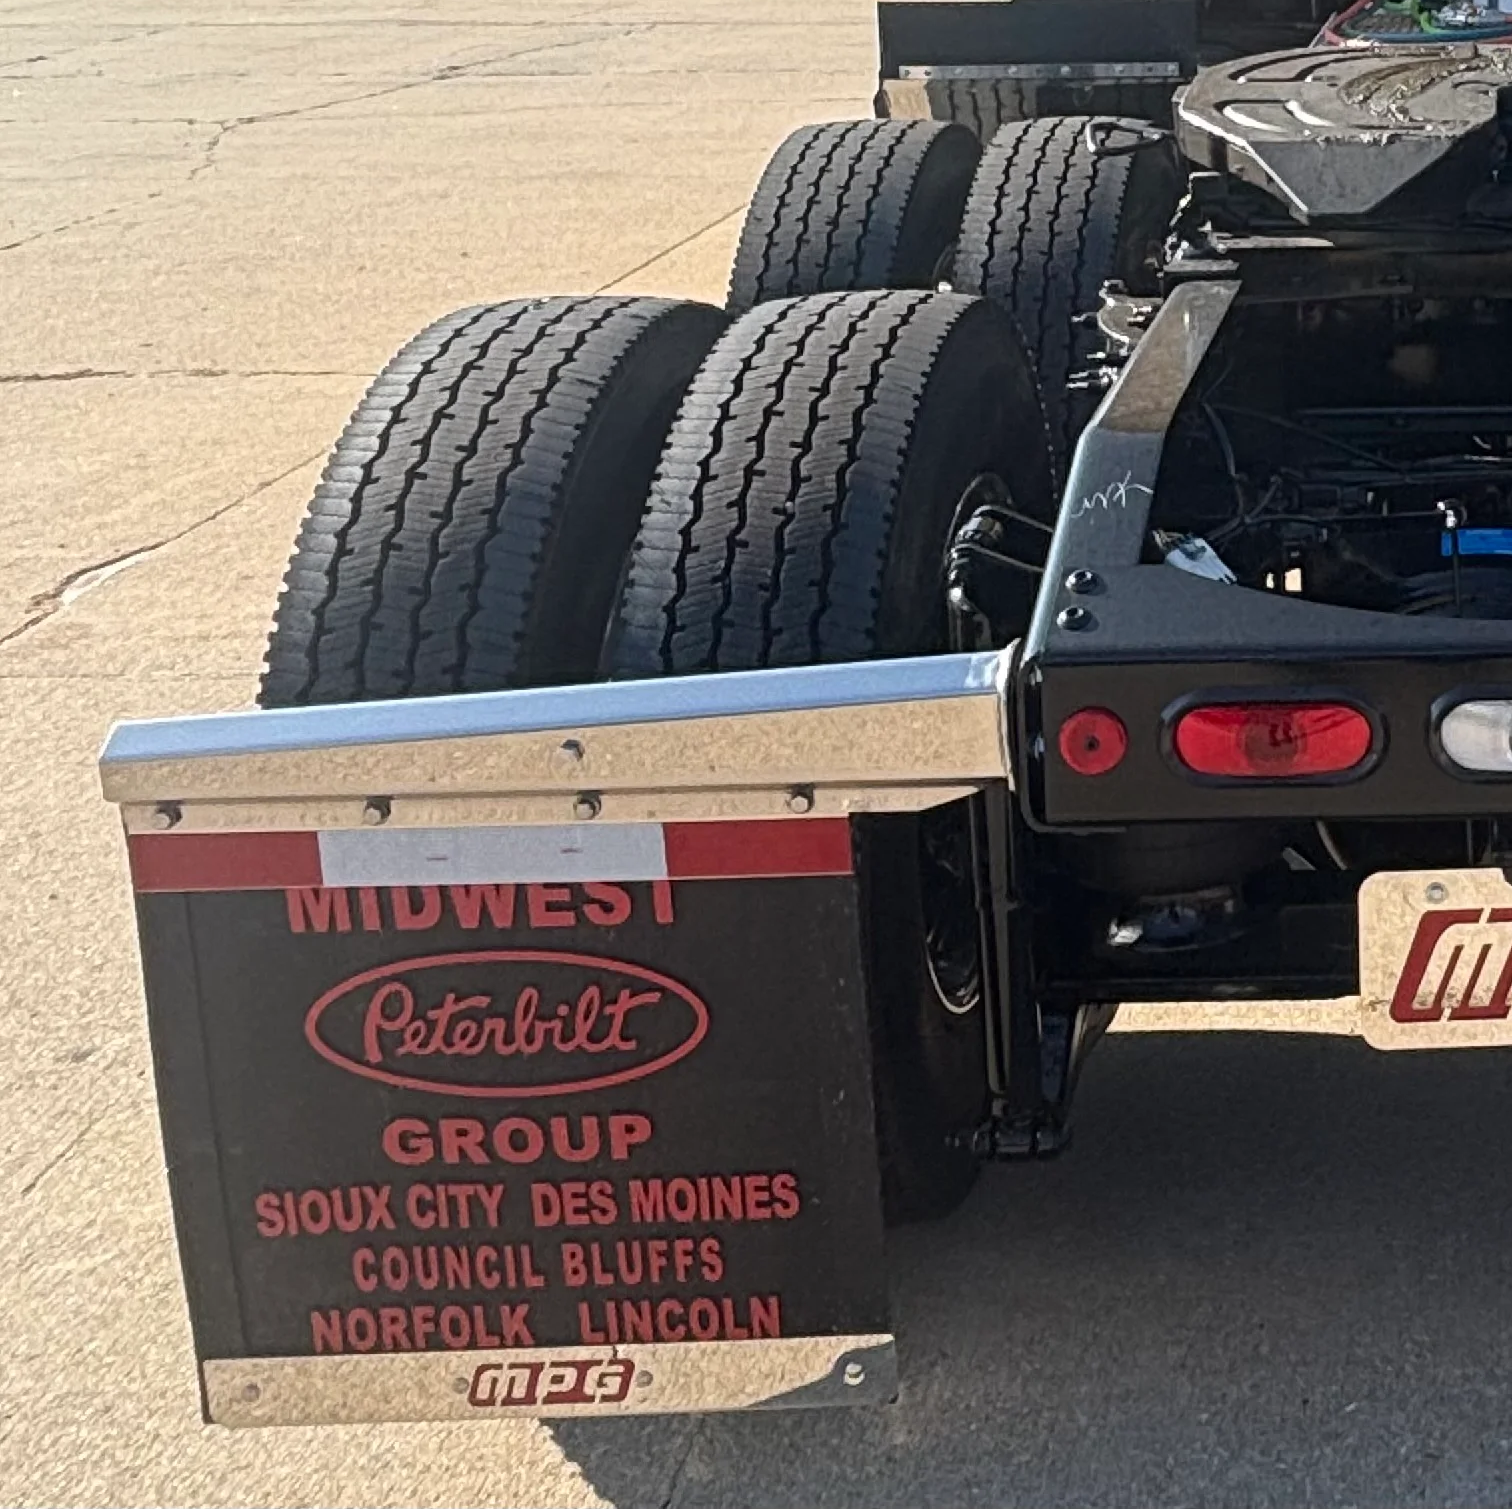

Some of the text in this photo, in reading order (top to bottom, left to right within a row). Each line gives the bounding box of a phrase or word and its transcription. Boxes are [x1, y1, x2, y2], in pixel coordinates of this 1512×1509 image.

[362, 981, 664, 1065] Peterbilt
[381, 1113, 654, 1166] GROUP
[255, 1172, 802, 1238] SIOUX CITY DES MOINES
[352, 1237, 725, 1292] COUNCIL BLUFFS
[311, 1295, 782, 1352] NORFOLK LINCOLN
[468, 1358, 636, 1407] MPG
